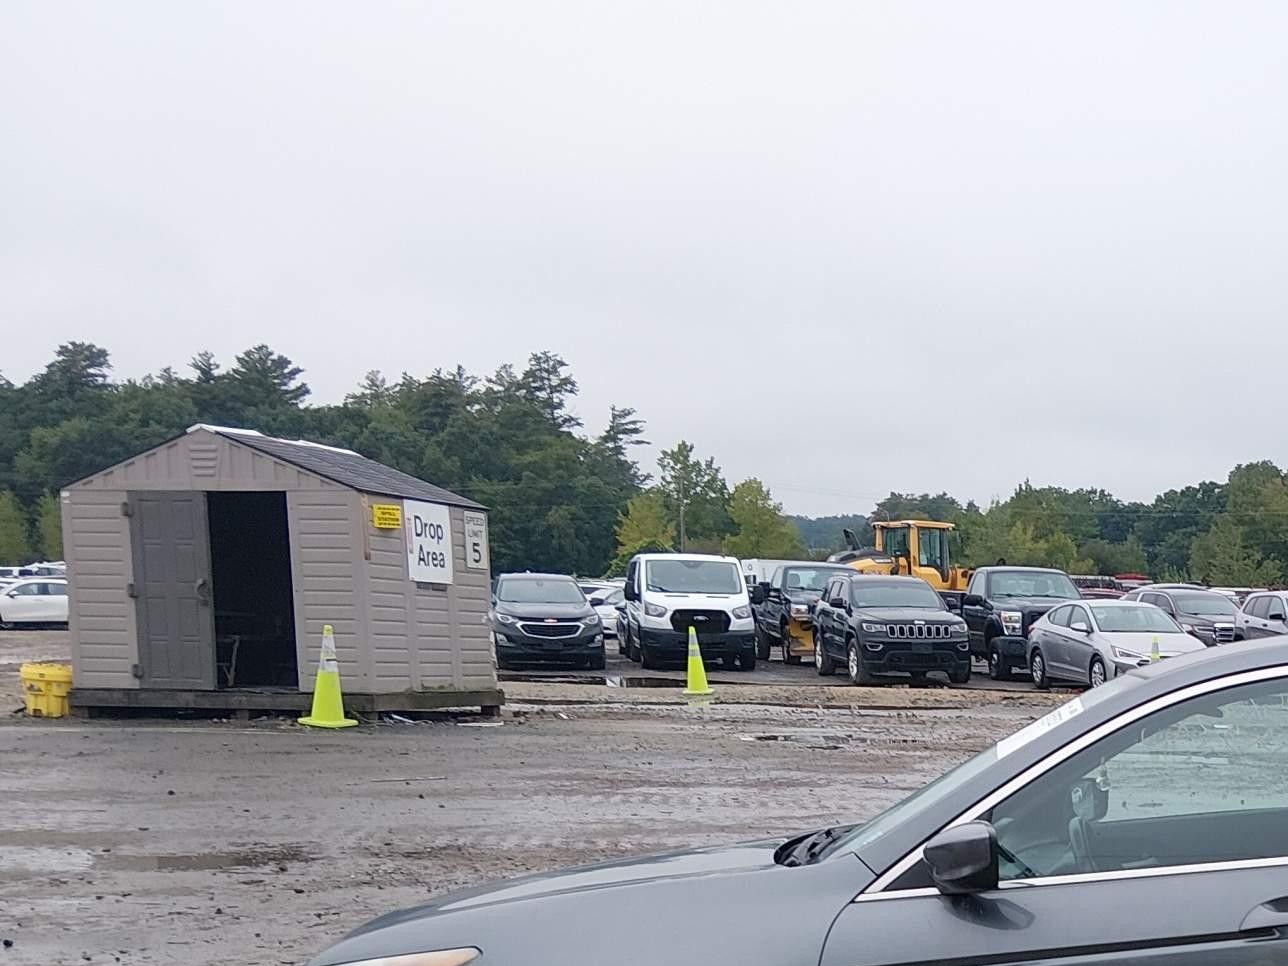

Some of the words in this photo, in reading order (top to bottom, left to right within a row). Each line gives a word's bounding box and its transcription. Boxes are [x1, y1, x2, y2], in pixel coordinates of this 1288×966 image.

[413, 515, 444, 544] Drop
[465, 515, 485, 527] SPEED
[417, 544, 446, 568] Area
[472, 542, 482, 564] 5
